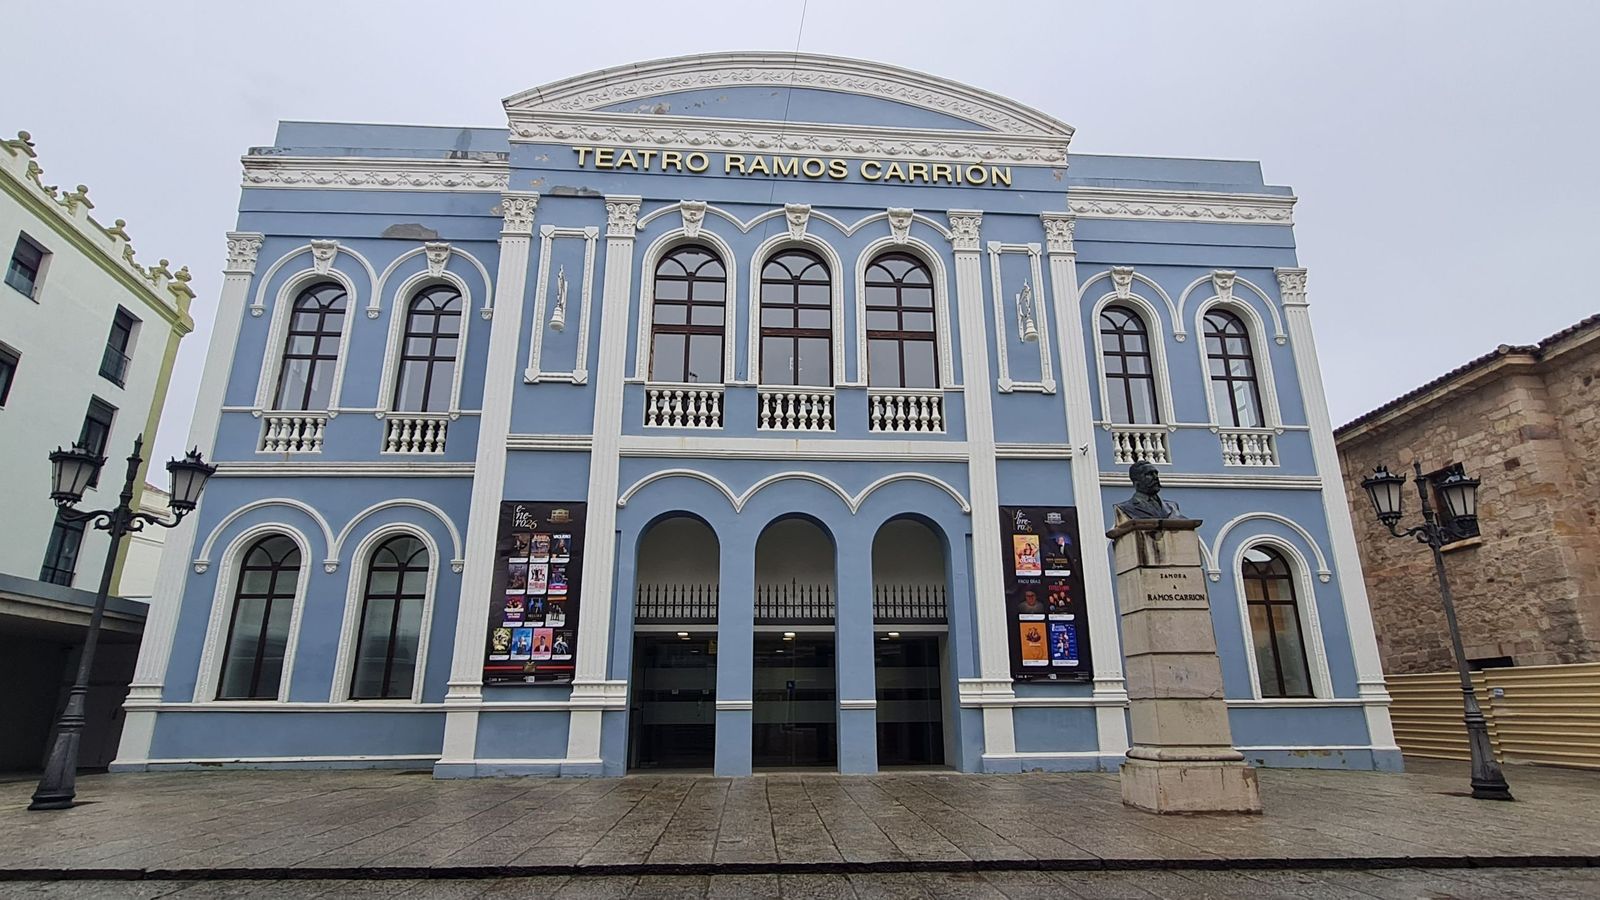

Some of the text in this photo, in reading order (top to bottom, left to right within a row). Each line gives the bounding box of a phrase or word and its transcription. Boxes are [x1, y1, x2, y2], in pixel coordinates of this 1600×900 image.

[572, 146, 1013, 186] TEATRO RAMOS CARRIÓN
[1147, 593, 1205, 601] RAMOS CARRION
